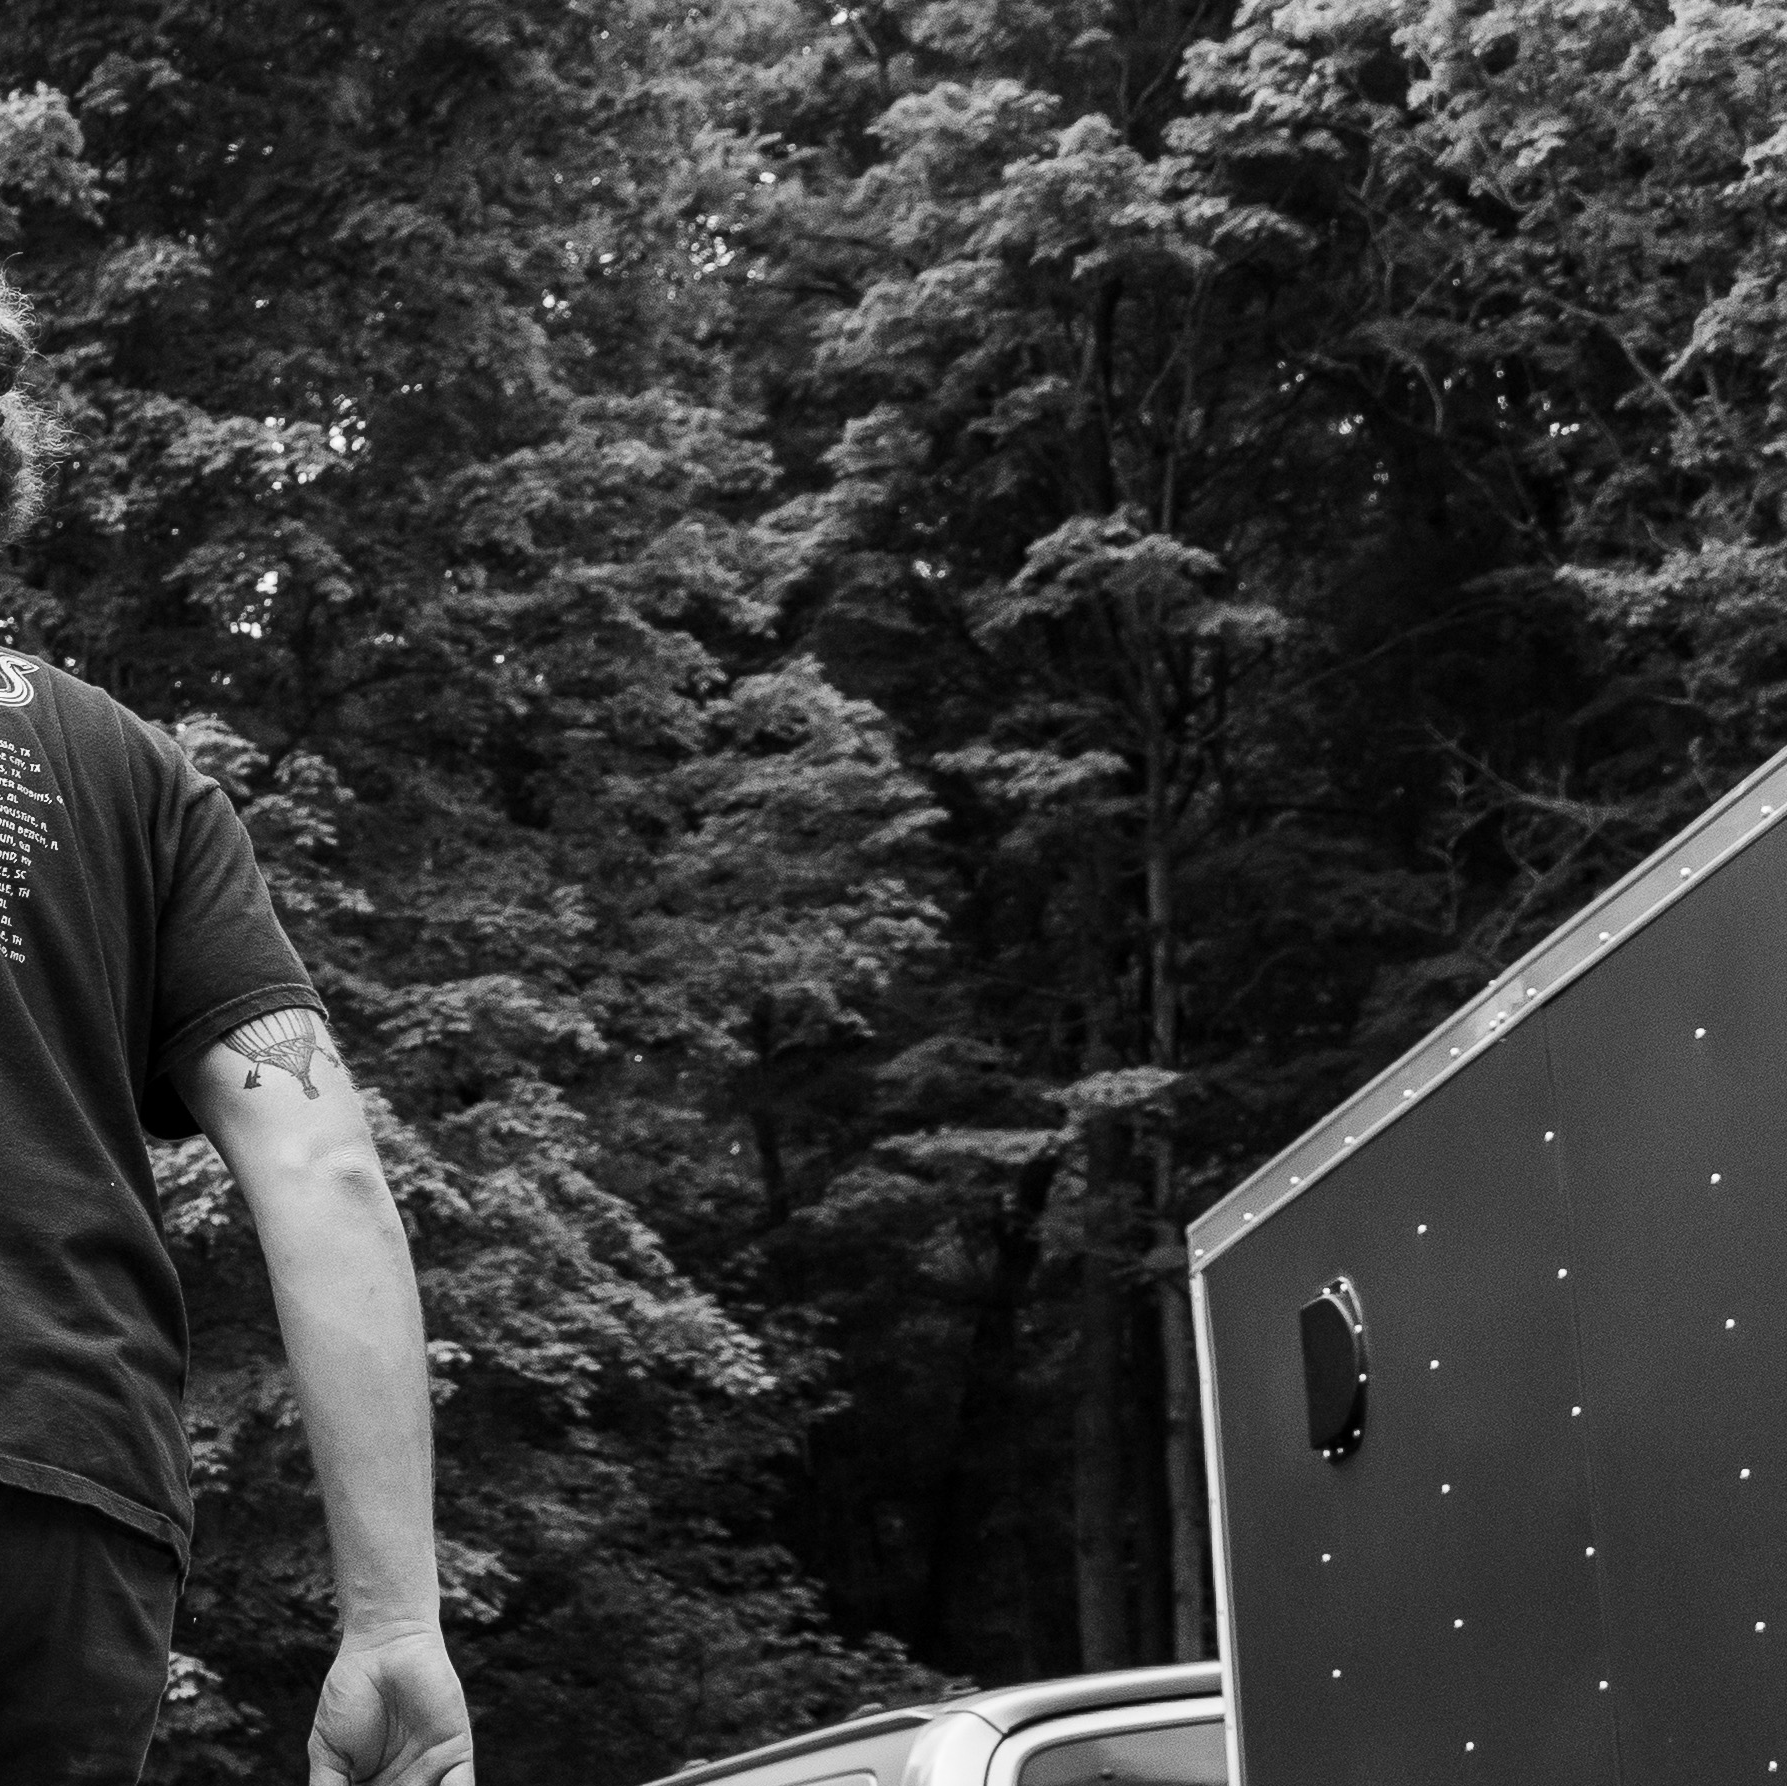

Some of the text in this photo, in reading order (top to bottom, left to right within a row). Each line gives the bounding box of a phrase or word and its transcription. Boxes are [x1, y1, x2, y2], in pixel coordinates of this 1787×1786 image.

[19, 747, 31, 758] TX
[29, 763, 41, 773] TX
[13, 869, 27, 880] SC
